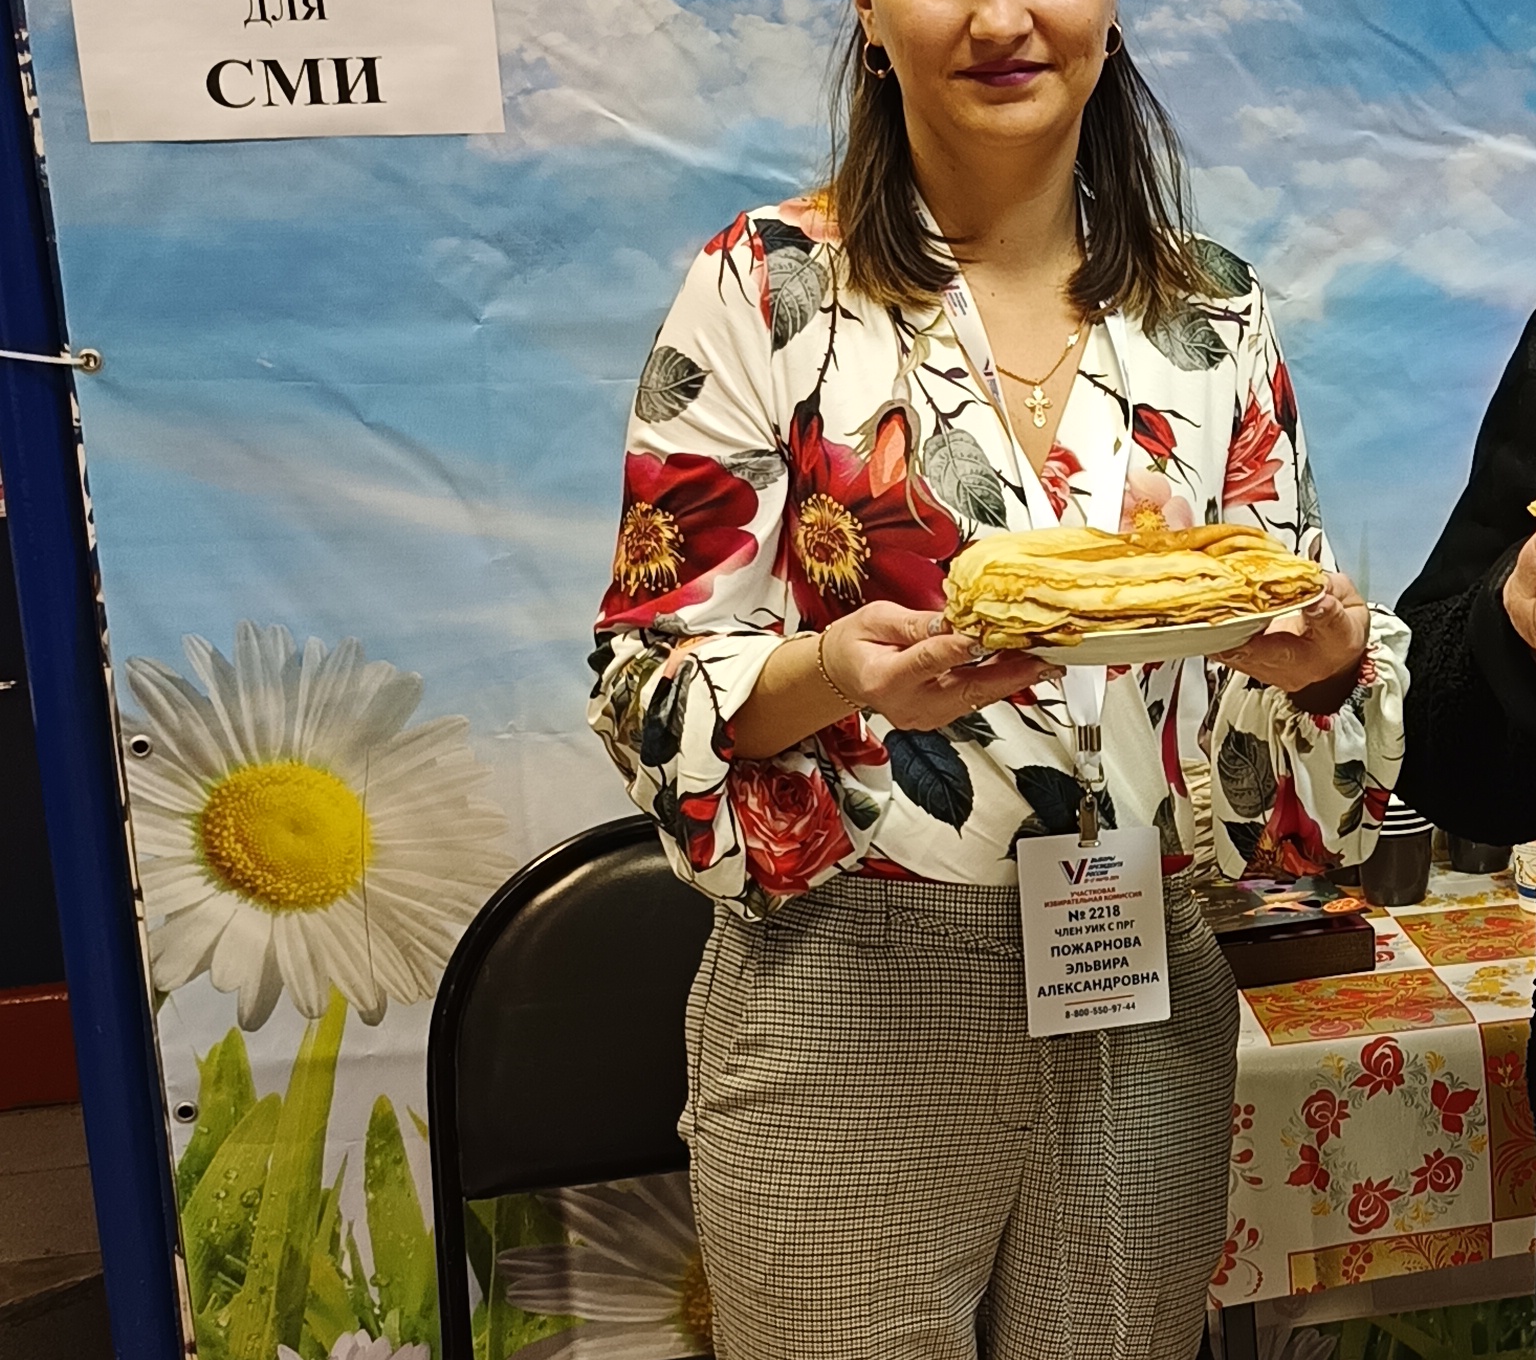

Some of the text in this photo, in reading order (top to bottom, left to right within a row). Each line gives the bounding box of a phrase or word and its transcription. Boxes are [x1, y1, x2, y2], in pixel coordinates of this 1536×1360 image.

[206, 55, 387, 109] СМИ
[1068, 905, 1120, 922] № 2218
[1054, 920, 1135, 937] ЧЛЕН УИК С ПРГ
[1050, 936, 1142, 957] ПОЖАРНОВА
[1065, 956, 1129, 975] ЭЛЬВИРА
[1037, 971, 1160, 998] АЛЕКСАНДРОВНА
[1064, 1002, 1136, 1019] 8-800-550-97-44
